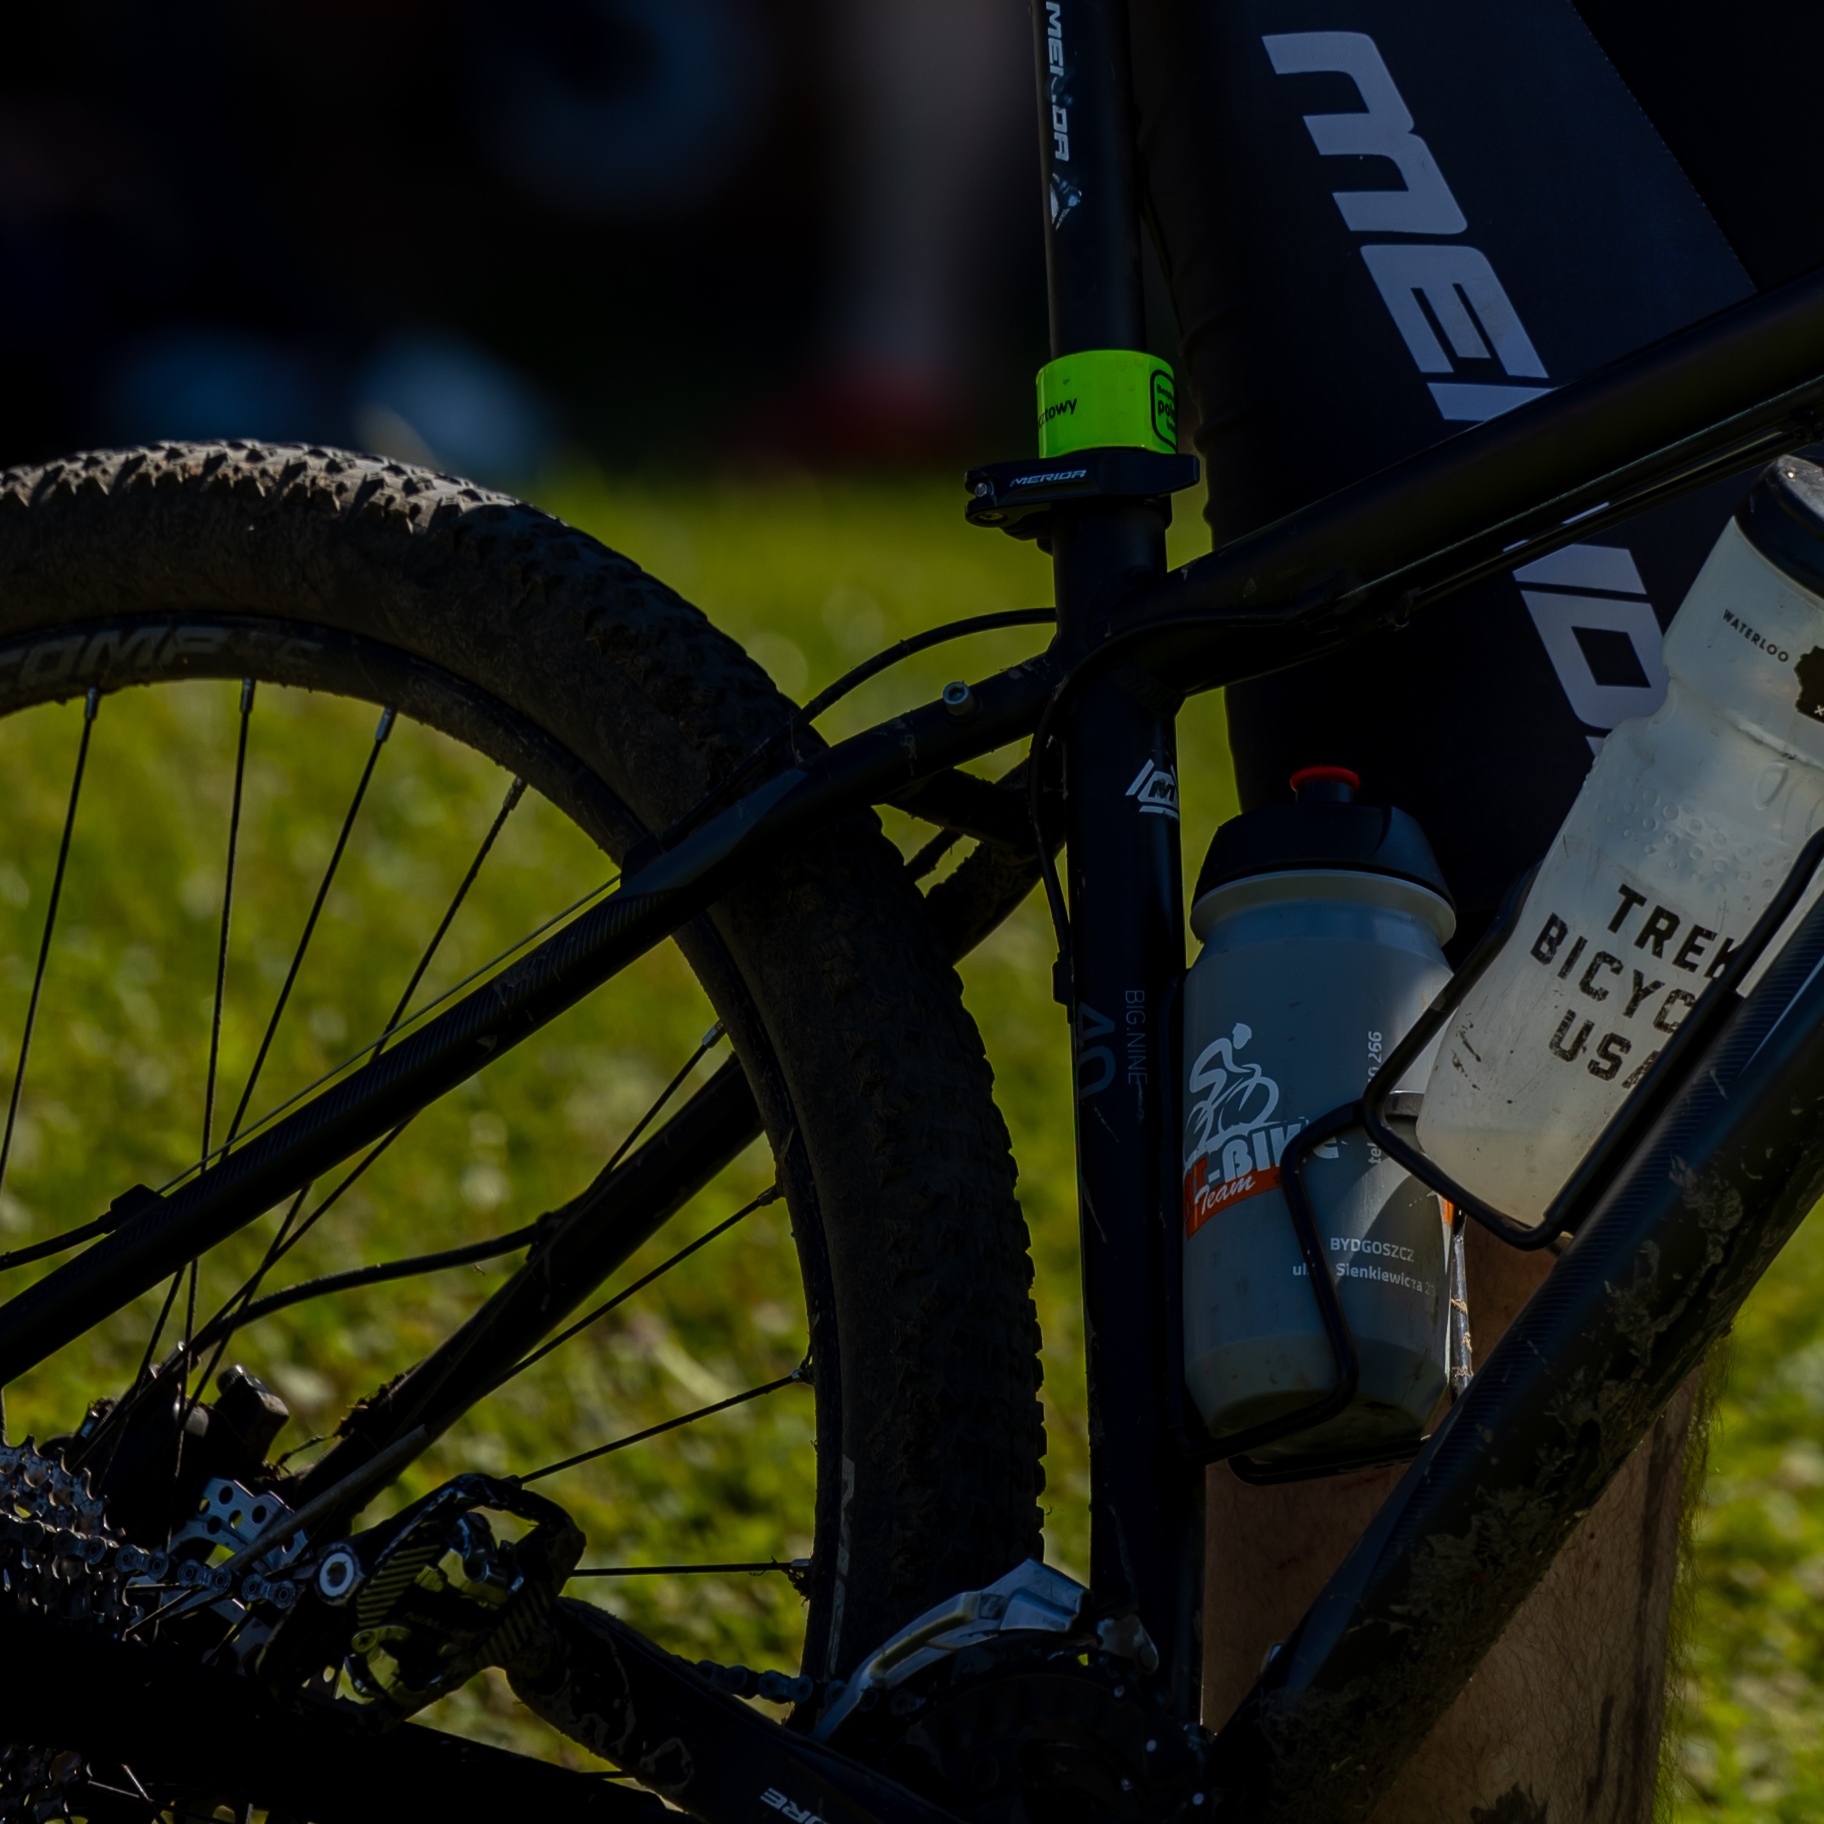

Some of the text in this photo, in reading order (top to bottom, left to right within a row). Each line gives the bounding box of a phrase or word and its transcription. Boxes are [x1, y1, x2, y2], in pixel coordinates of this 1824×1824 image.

[1009, 469, 1087, 488] MERIDA
[1722, 608, 1790, 663] WATERLOO
[1125, 989, 1148, 1085] BIG.NINE
[1367, 1030, 1383, 1063] 266
[1194, 1174, 1257, 1216] Team
[1329, 1237, 1415, 1264] BYDGOSZCZ
[1335, 1262, 1423, 1293] Sienkiewicza
